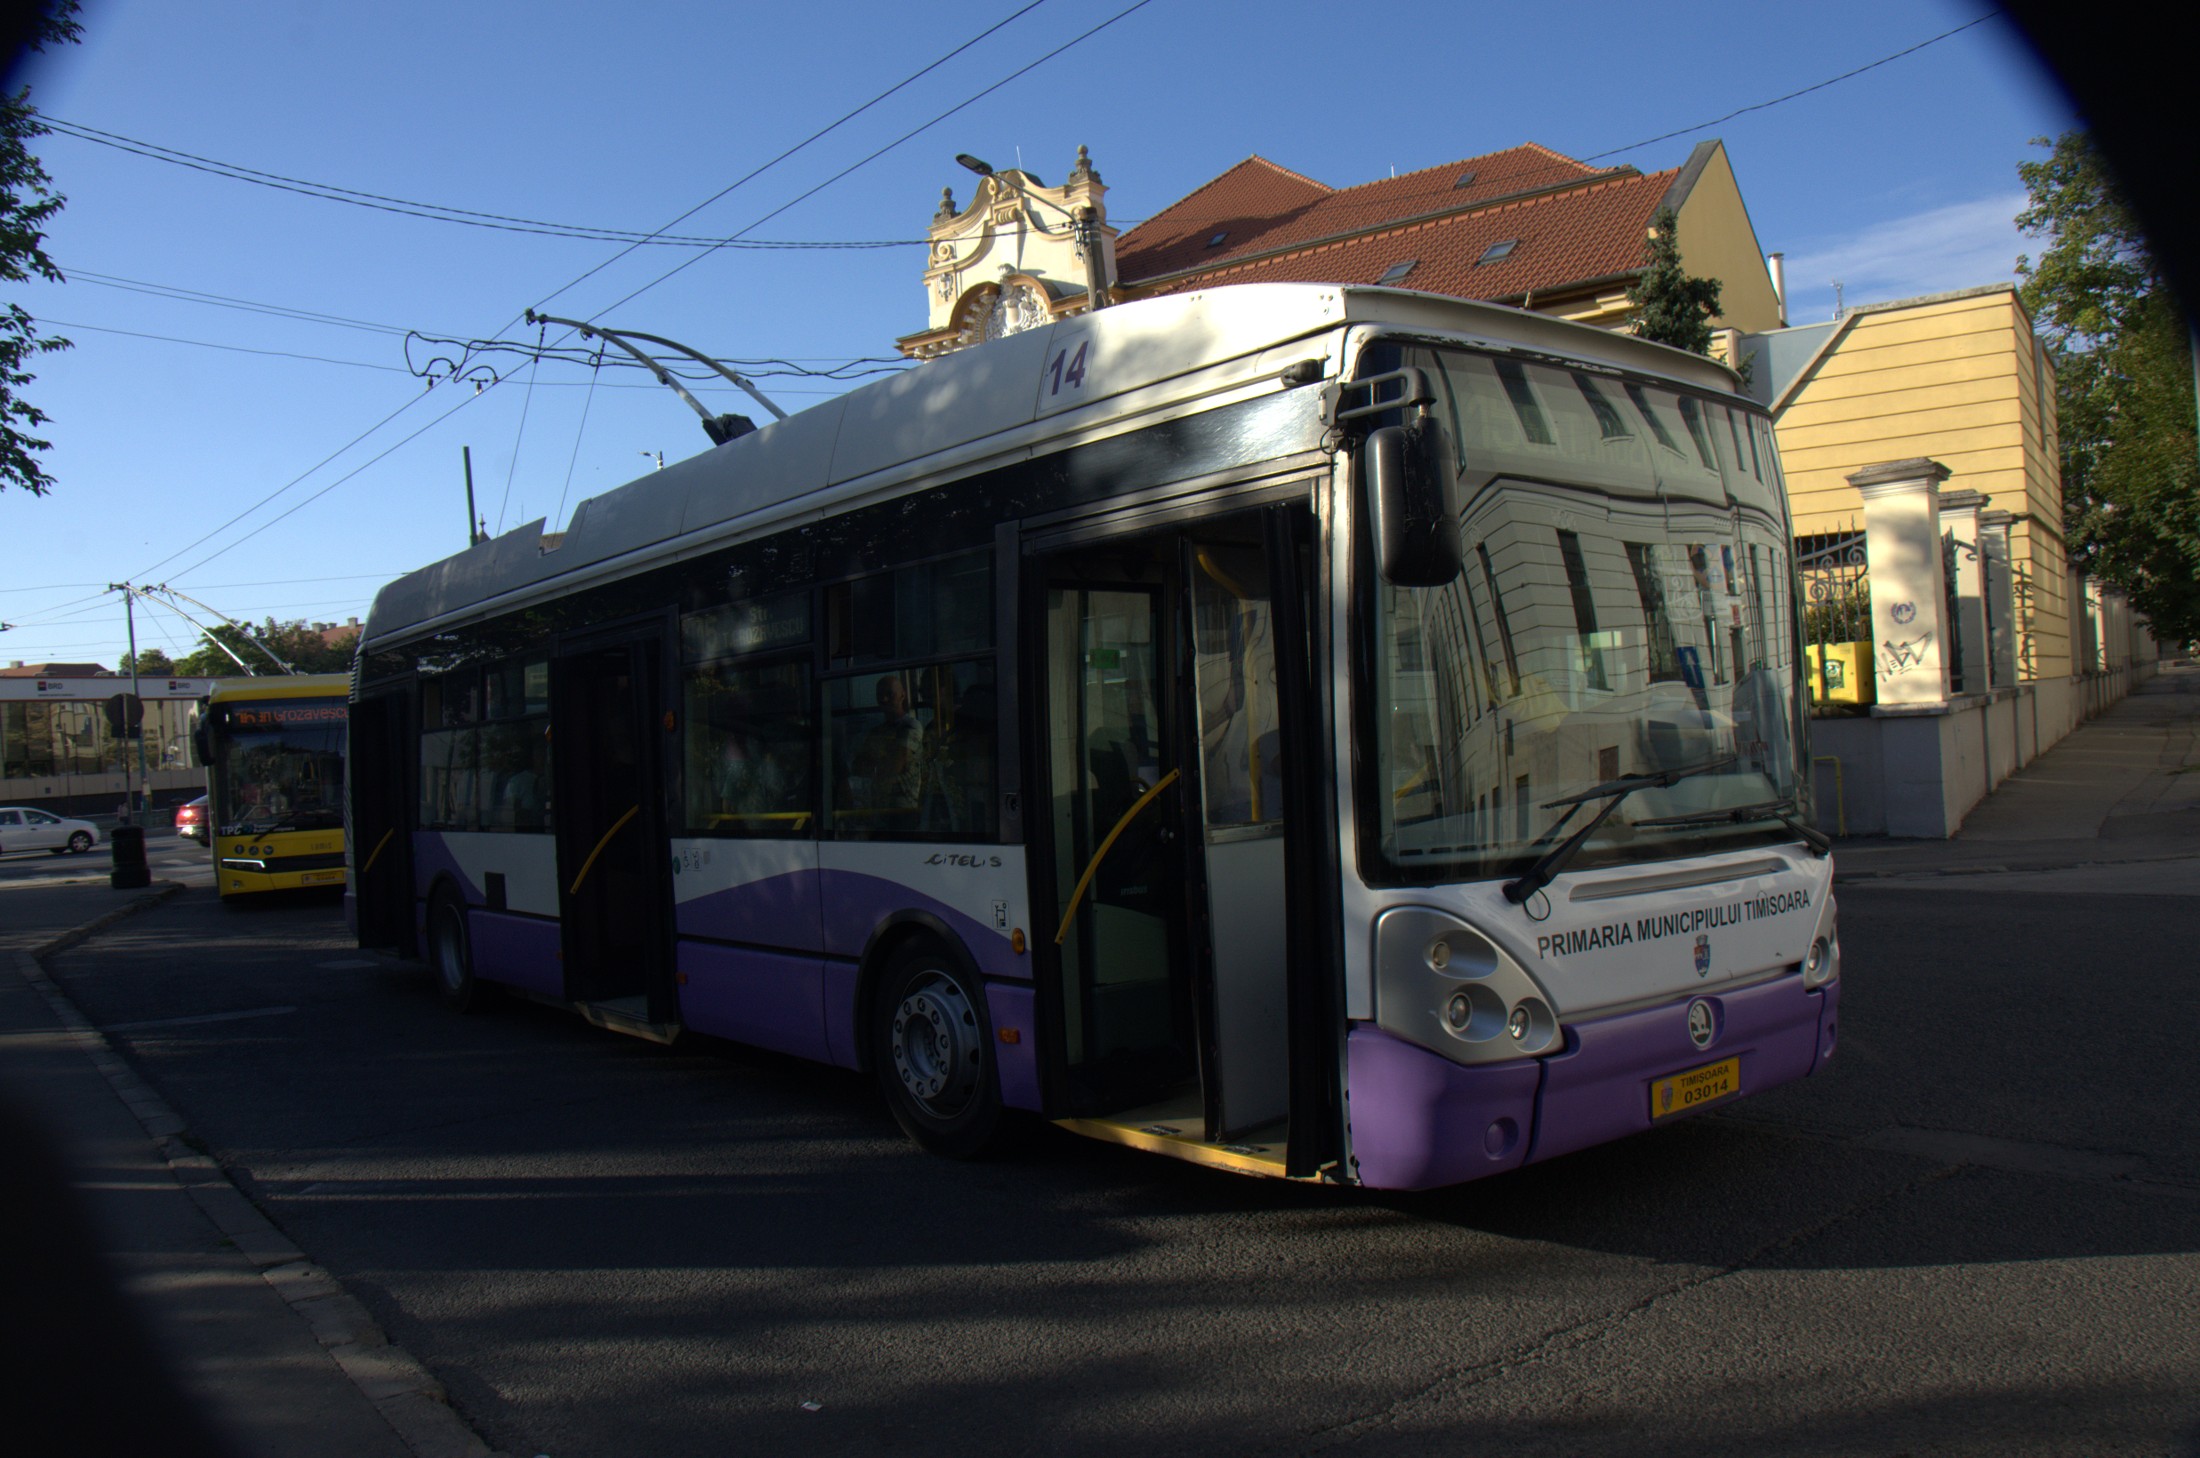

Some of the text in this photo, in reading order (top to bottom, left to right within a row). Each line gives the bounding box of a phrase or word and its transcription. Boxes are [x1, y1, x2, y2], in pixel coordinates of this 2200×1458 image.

[1050, 340, 1089, 396] 14
[1538, 889, 1811, 959] PRIMARIA MUNICIPIULUI TIMISOARA
[1684, 1078, 1729, 1104] 03014
